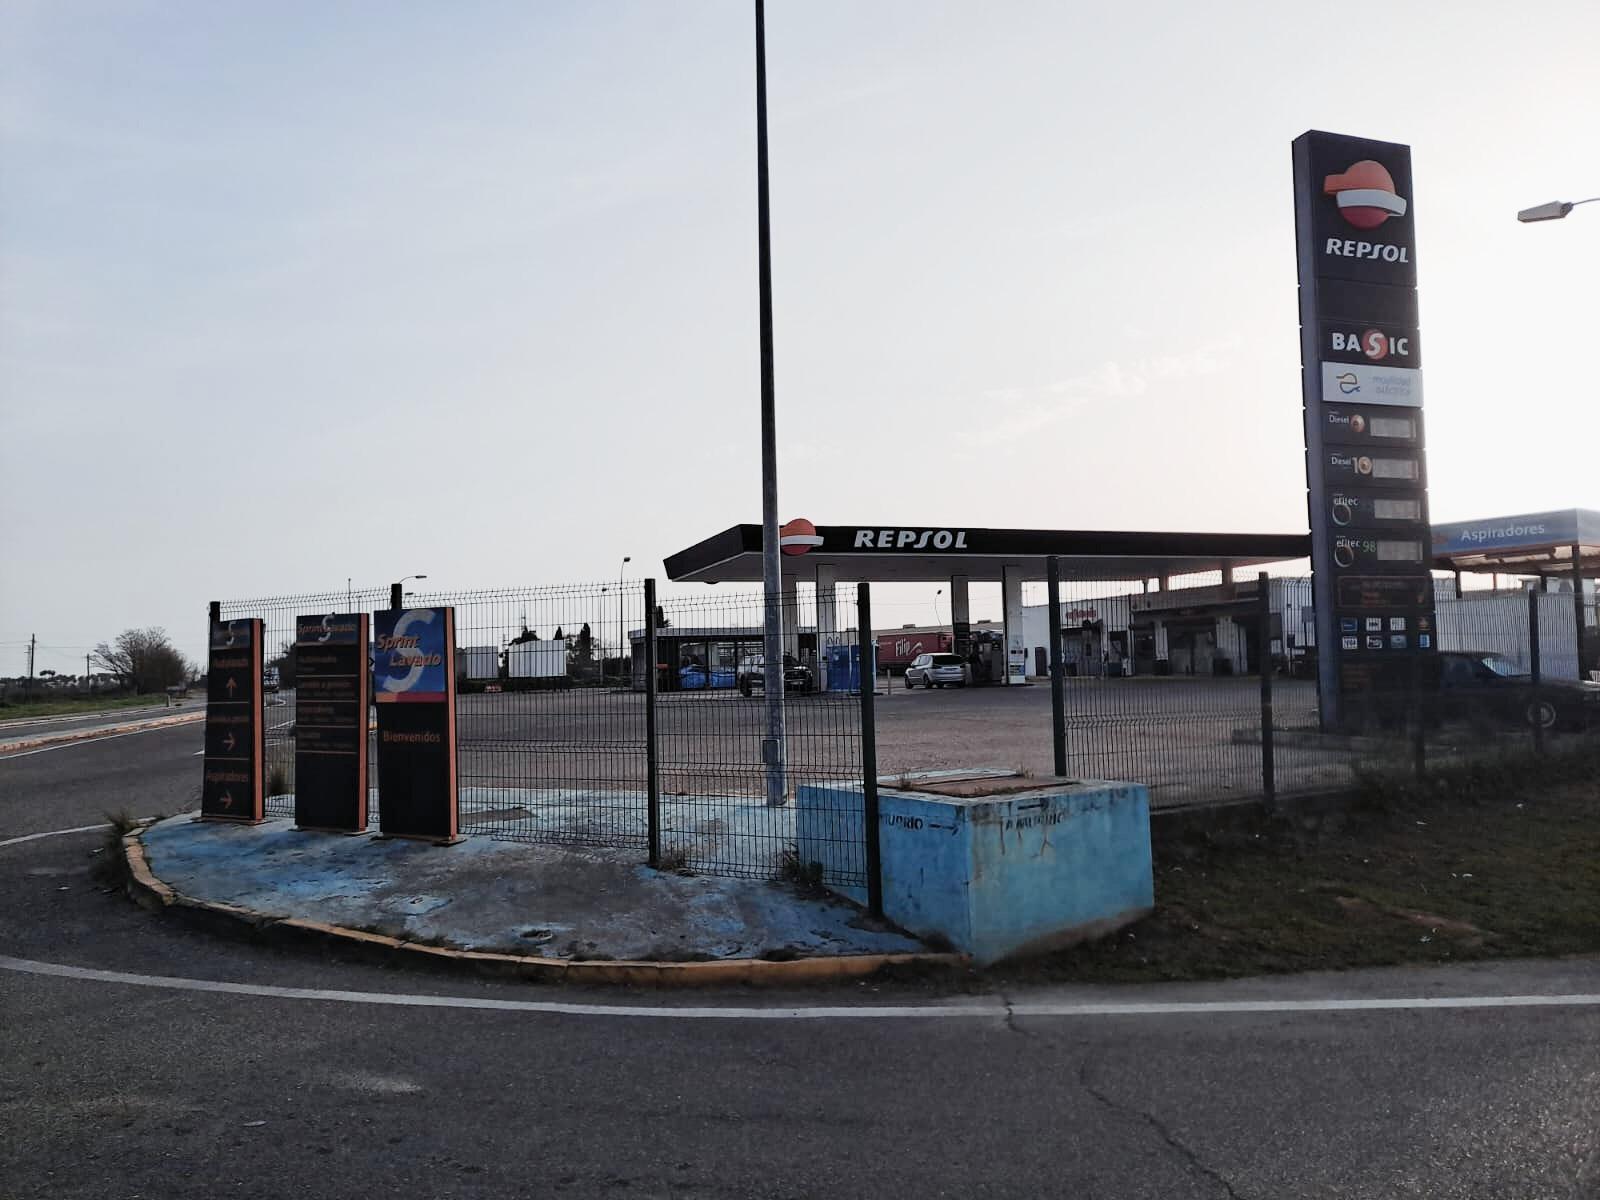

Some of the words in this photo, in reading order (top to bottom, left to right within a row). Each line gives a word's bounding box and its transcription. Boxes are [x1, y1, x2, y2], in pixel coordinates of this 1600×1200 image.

[1325, 238, 1409, 264] REPSOL
[1331, 330, 1410, 359] BASIC
[1328, 414, 1350, 424] Diesel
[1330, 456, 1352, 465] Diesel
[853, 529, 968, 550] REPSOL
[1460, 523, 1546, 543] Aspiradores
[1362, 540, 1377, 553] 98
[376, 633, 421, 652] Sprint
[389, 652, 442, 668] Lavado
[383, 729, 441, 744] Bienvenidos
